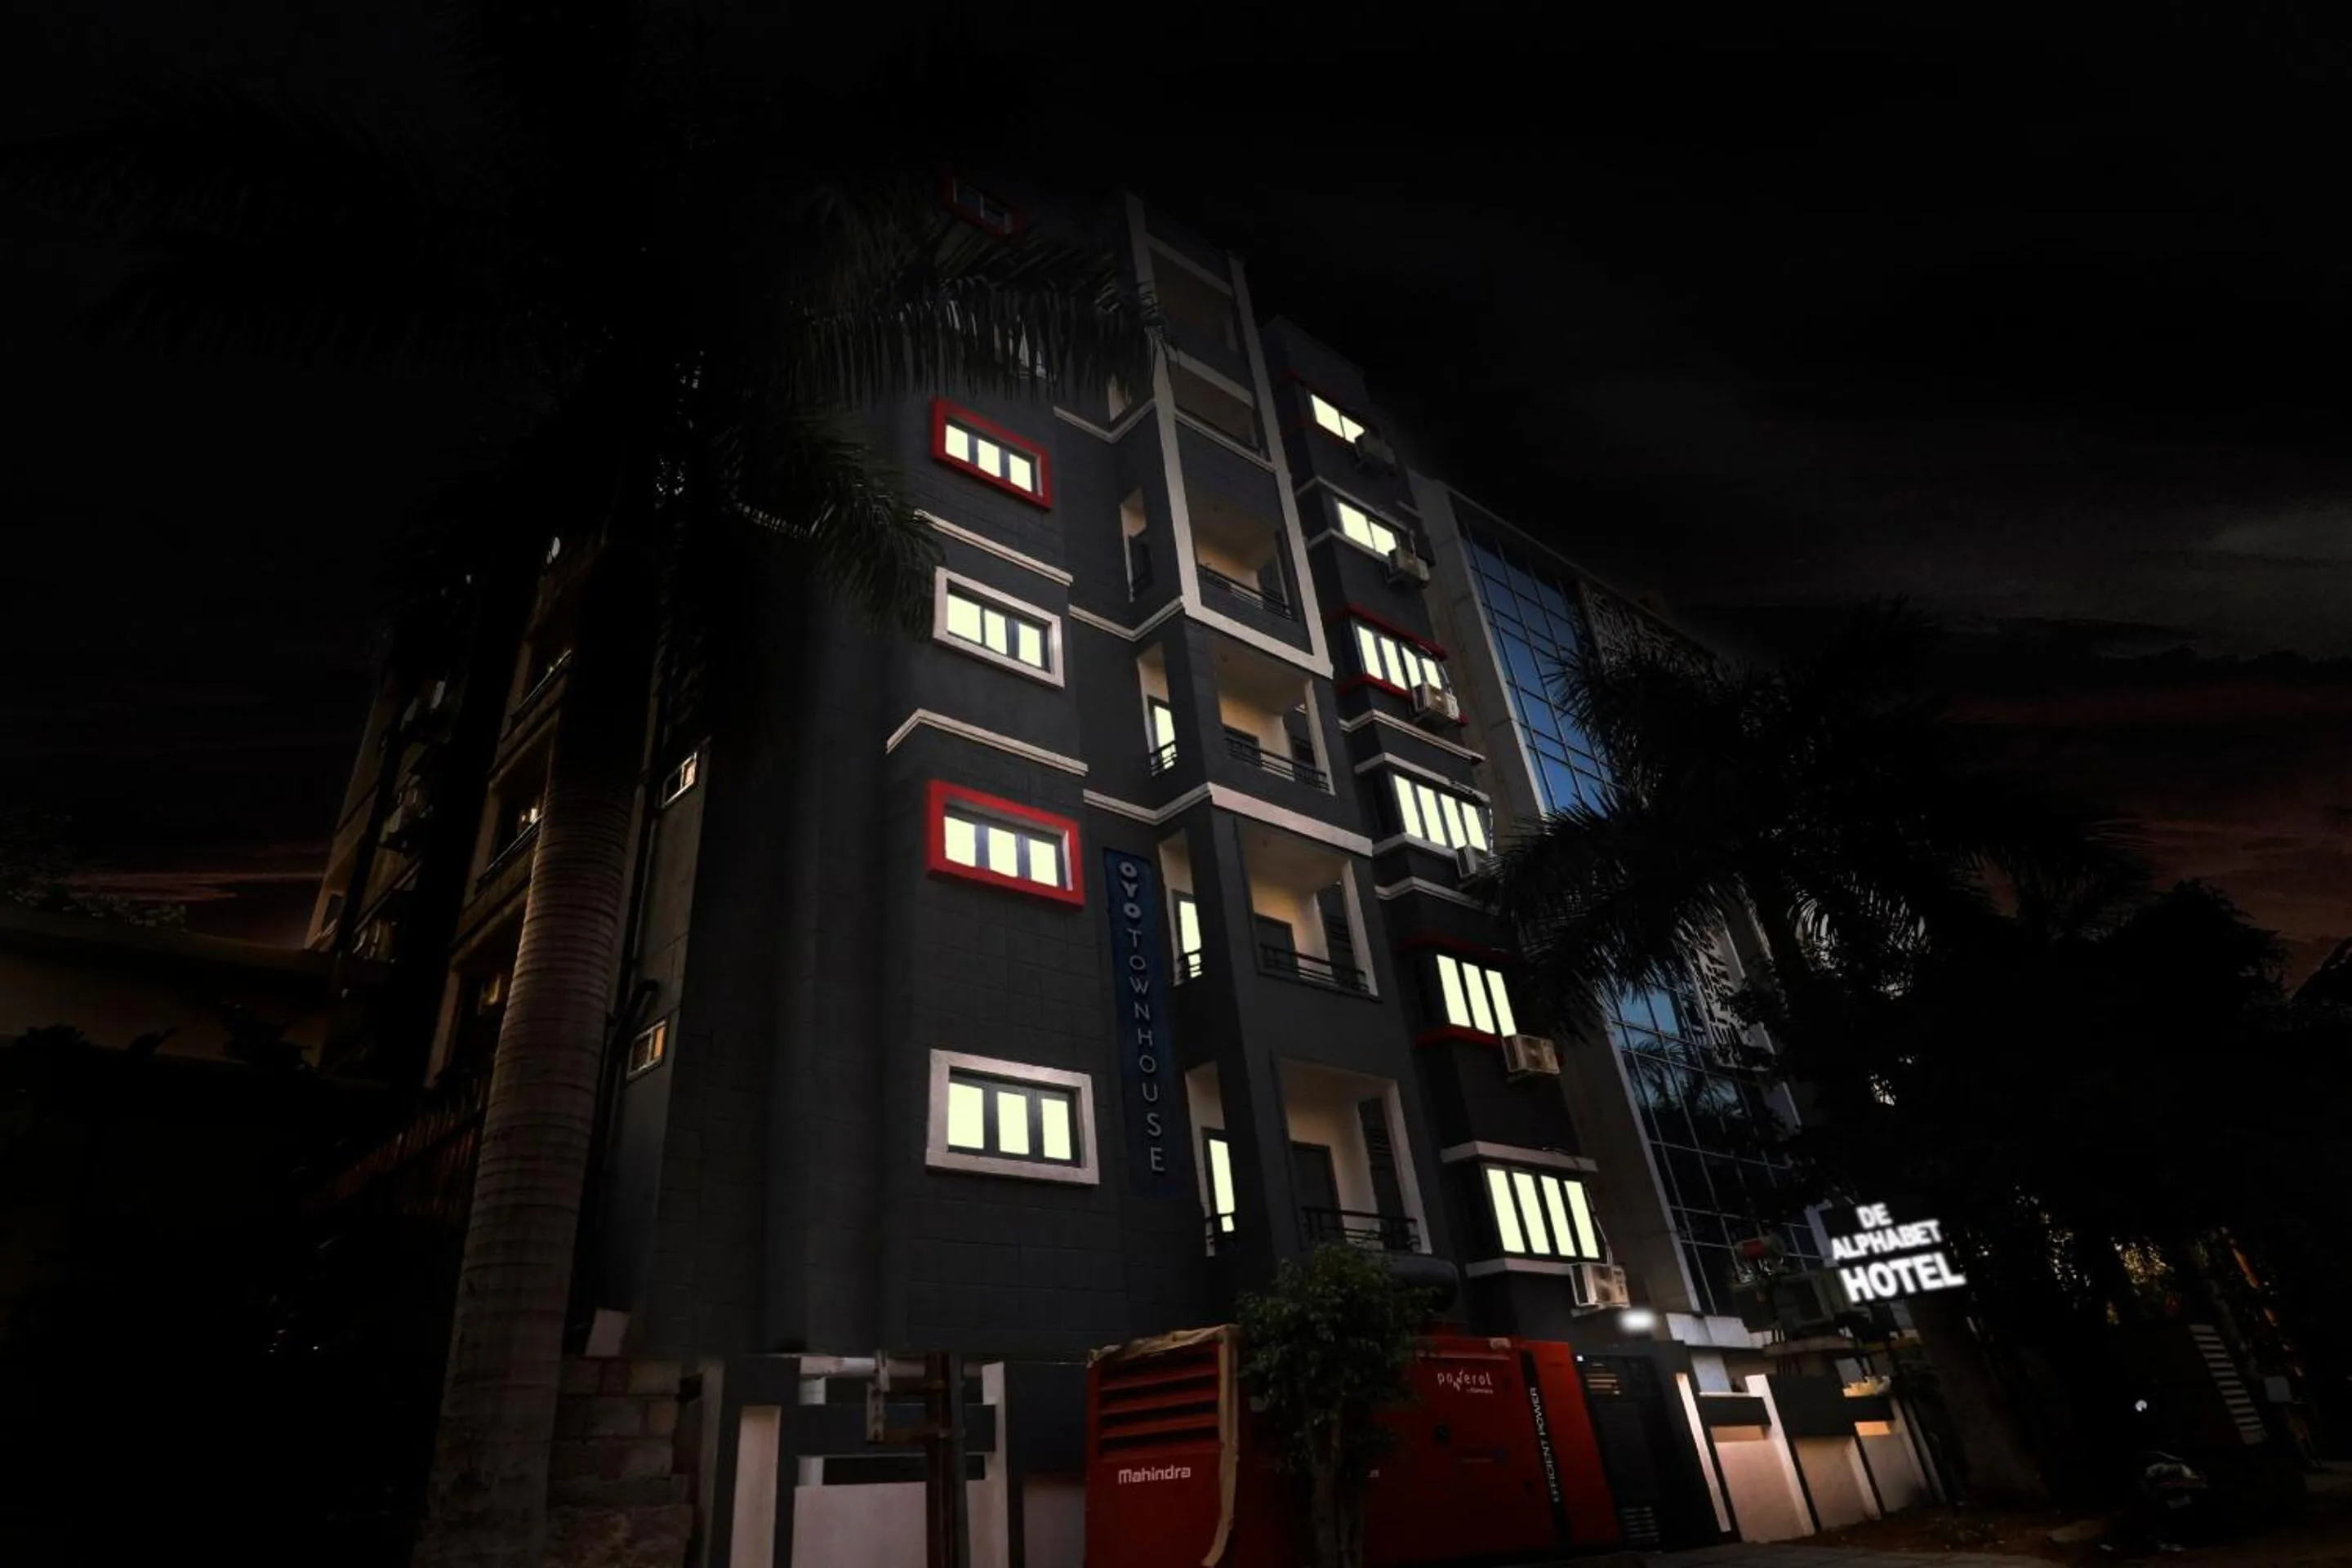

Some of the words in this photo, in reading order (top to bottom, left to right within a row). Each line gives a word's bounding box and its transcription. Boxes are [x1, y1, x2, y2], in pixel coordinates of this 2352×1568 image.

[1118, 860, 1142, 920] OYO
[1126, 928, 1166, 1174] TOWNHOUSE
[1831, 1218, 1941, 1260] ALPHABET
[1855, 1202, 1892, 1229] DE
[1840, 1251, 1967, 1303] HOTEL
